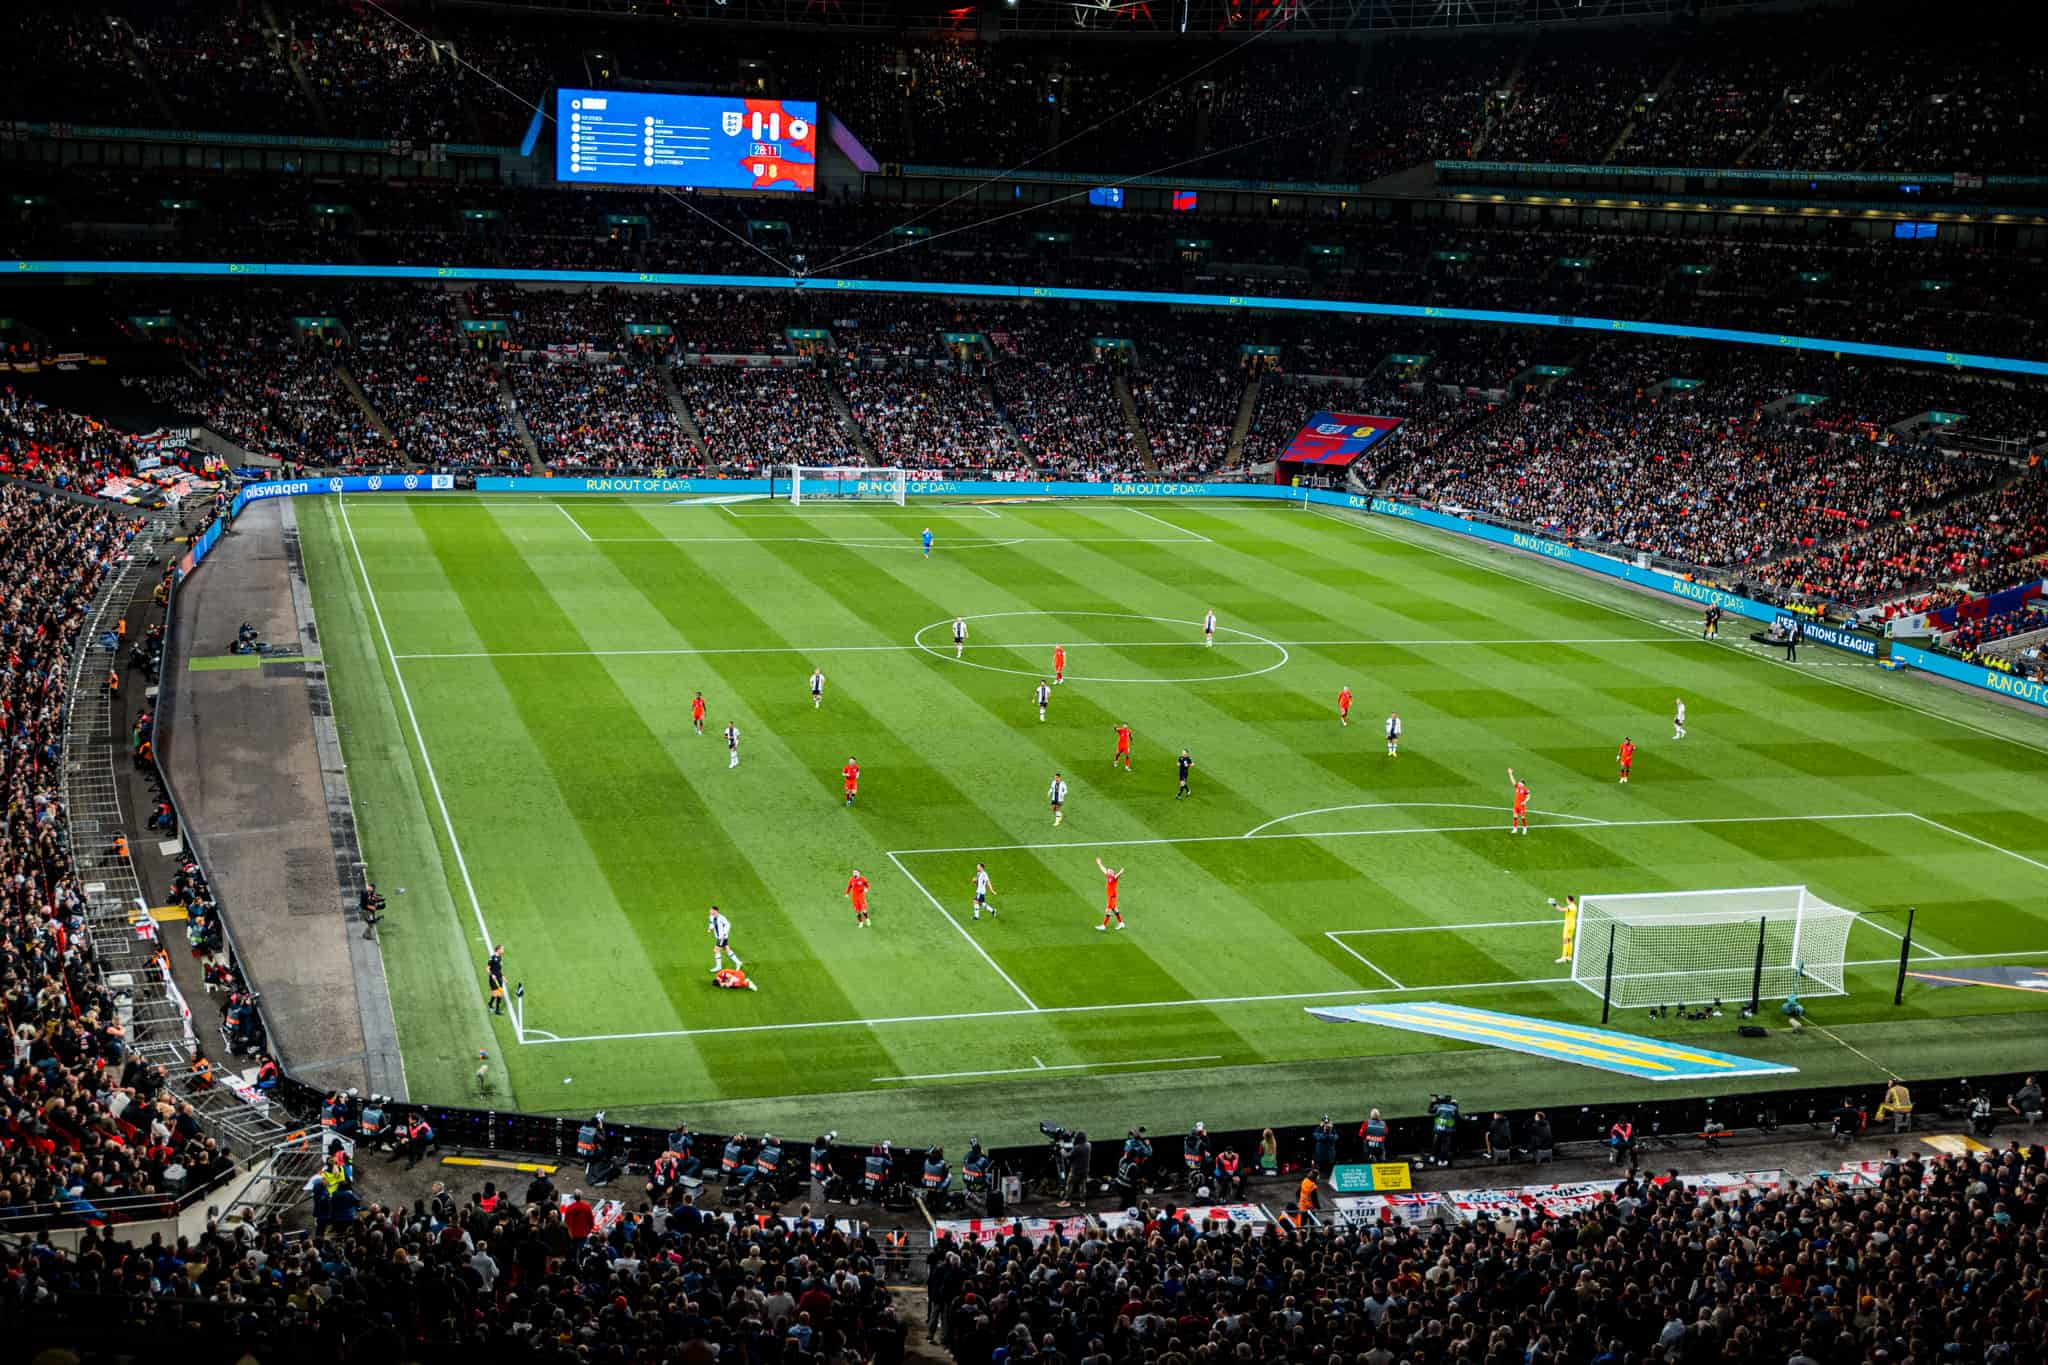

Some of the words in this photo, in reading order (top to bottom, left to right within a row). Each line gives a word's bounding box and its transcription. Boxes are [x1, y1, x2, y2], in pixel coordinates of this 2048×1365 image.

[754, 145, 777, 155] 28:11
[246, 482, 308, 499] olkswagen
[586, 479, 612, 490] RUN
[615, 479, 641, 490] OUT
[644, 479, 661, 491] OF
[664, 480, 690, 492] DATA
[858, 481, 882, 492] RUN
[912, 482, 928, 493] OF
[930, 483, 956, 494] DATA
[1112, 484, 1134, 494] RUN
[1136, 484, 1160, 494] OUT
[1163, 484, 1178, 494] OF
[1181, 484, 1207, 495] DATA
[1514, 534, 1528, 546] RUN
[1529, 538, 1544, 552] OUT
[1673, 580, 1691, 596] RUN
[1691, 586, 1710, 602] OUT
[1711, 591, 1724, 607] OF
[1724, 594, 1744, 609] DATA
[1838, 634, 1875, 654] LEAGUE
[1986, 671, 2012, 693] RUN
[2014, 680, 2042, 702] OUT
[2042, 689, 2048, 705] O
